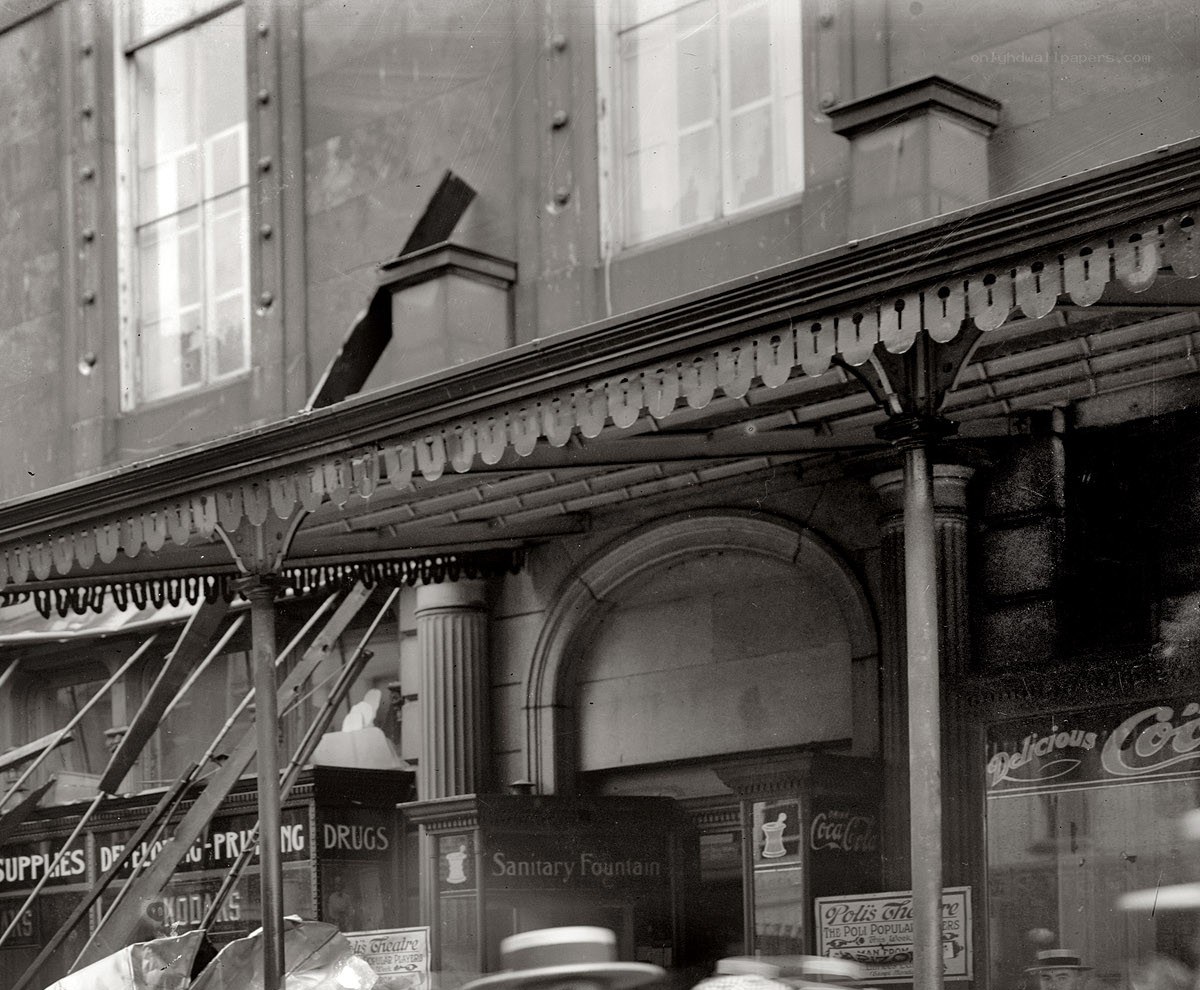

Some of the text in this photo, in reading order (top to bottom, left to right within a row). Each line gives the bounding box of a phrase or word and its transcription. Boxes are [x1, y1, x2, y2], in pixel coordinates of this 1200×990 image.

[987, 726, 1098, 787] Delicious
[323, 823, 388, 850] DRUGS
[810, 812, 842, 851] Coca
[492, 852, 660, 883] Sanitary Fountain
[824, 927, 841, 939] THE
[844, 924, 867, 939] POLI
